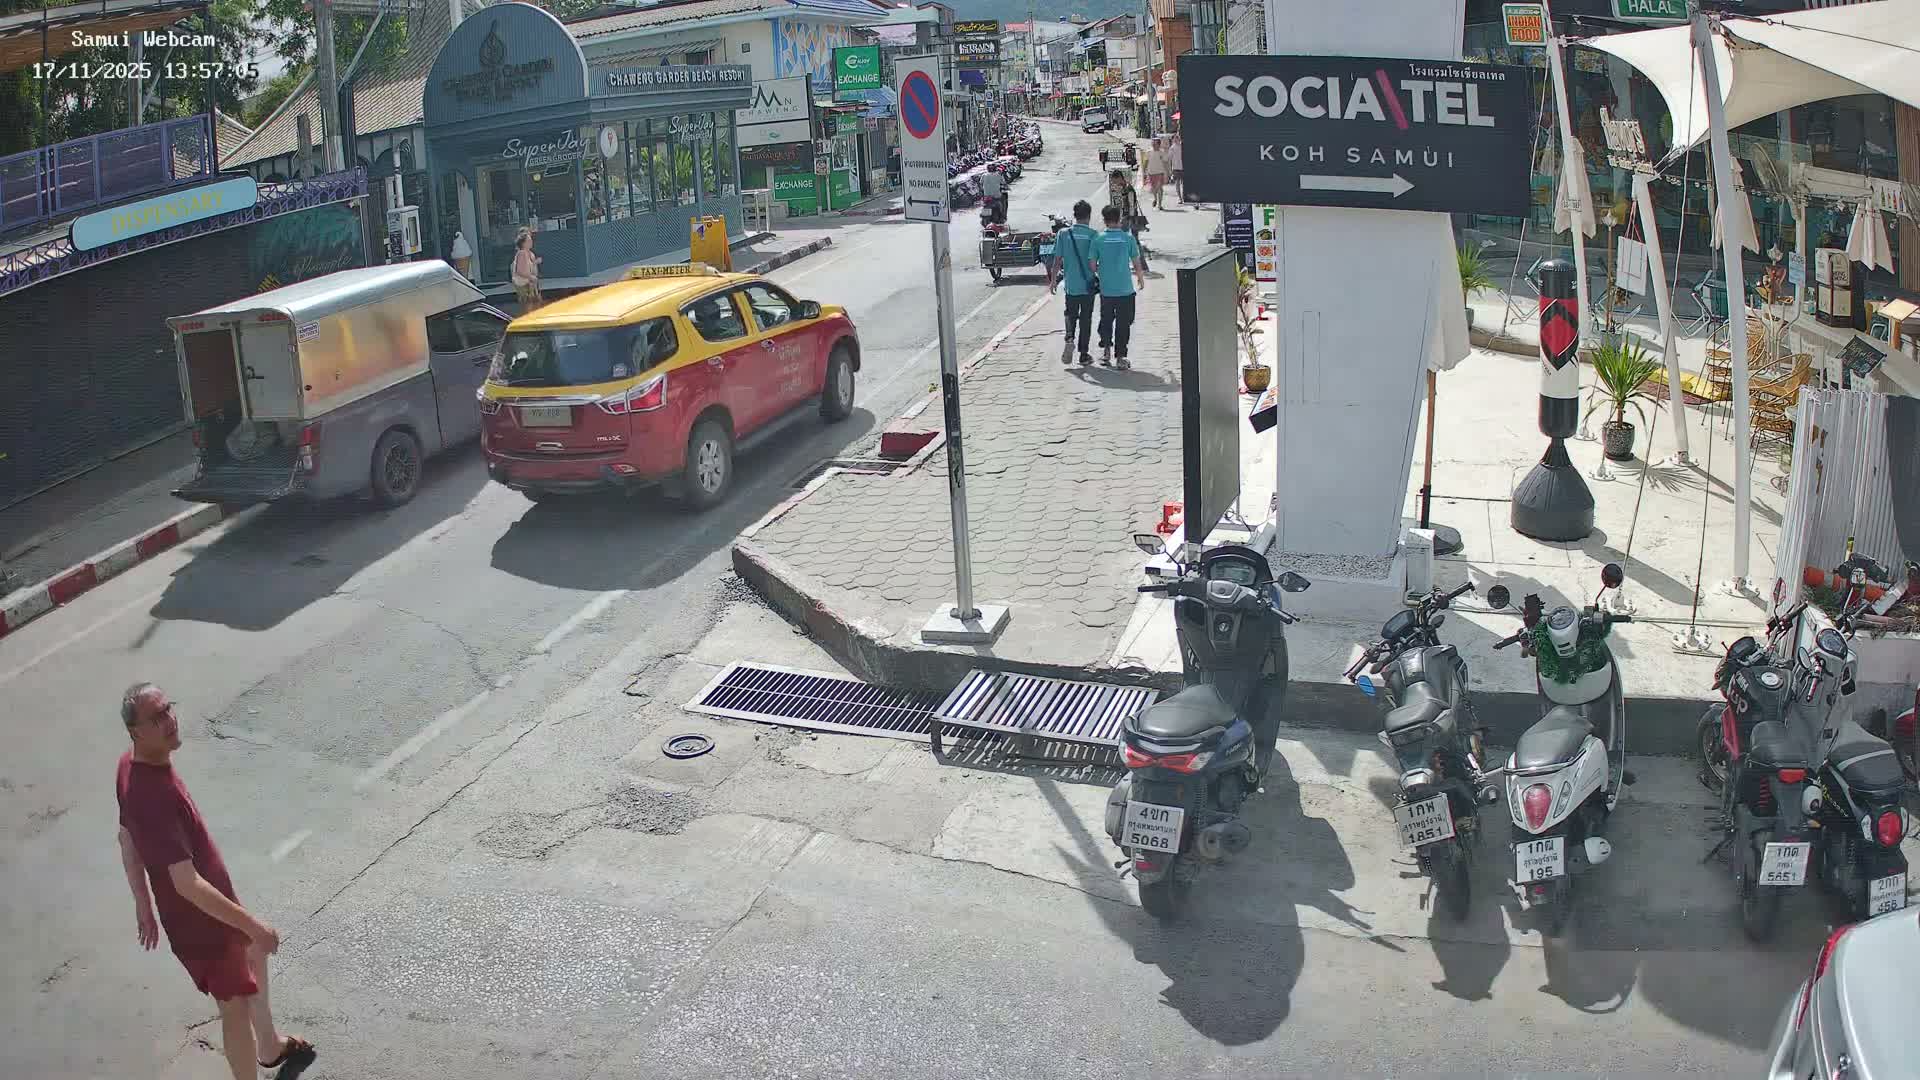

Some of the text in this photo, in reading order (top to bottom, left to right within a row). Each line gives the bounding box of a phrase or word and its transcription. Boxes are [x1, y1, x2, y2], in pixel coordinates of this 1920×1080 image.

[1627, 0, 1678, 14] HALAL
[1508, 15, 1542, 28] INDIAN
[1511, 28, 1541, 41] FOOD
[609, 69, 746, 86] CHAWENG GARDEN BEACH RESORT
[838, 73, 879, 84] EXCHANGE
[740, 106, 799, 117] CHAWENG
[502, 129, 591, 169] SuperJay
[1259, 144, 1453, 168] KOH SAMUI
[775, 179, 814, 190] EXCHANGE
[909, 180, 941, 189] NO PARKING
[111, 189, 224, 236] DISPENSARY
[1139, 807, 1169, 823] 4ขก
[1130, 832, 1169, 849] 5068
[1408, 826, 1442, 843] 1851
[1528, 865, 1553, 881] 195
